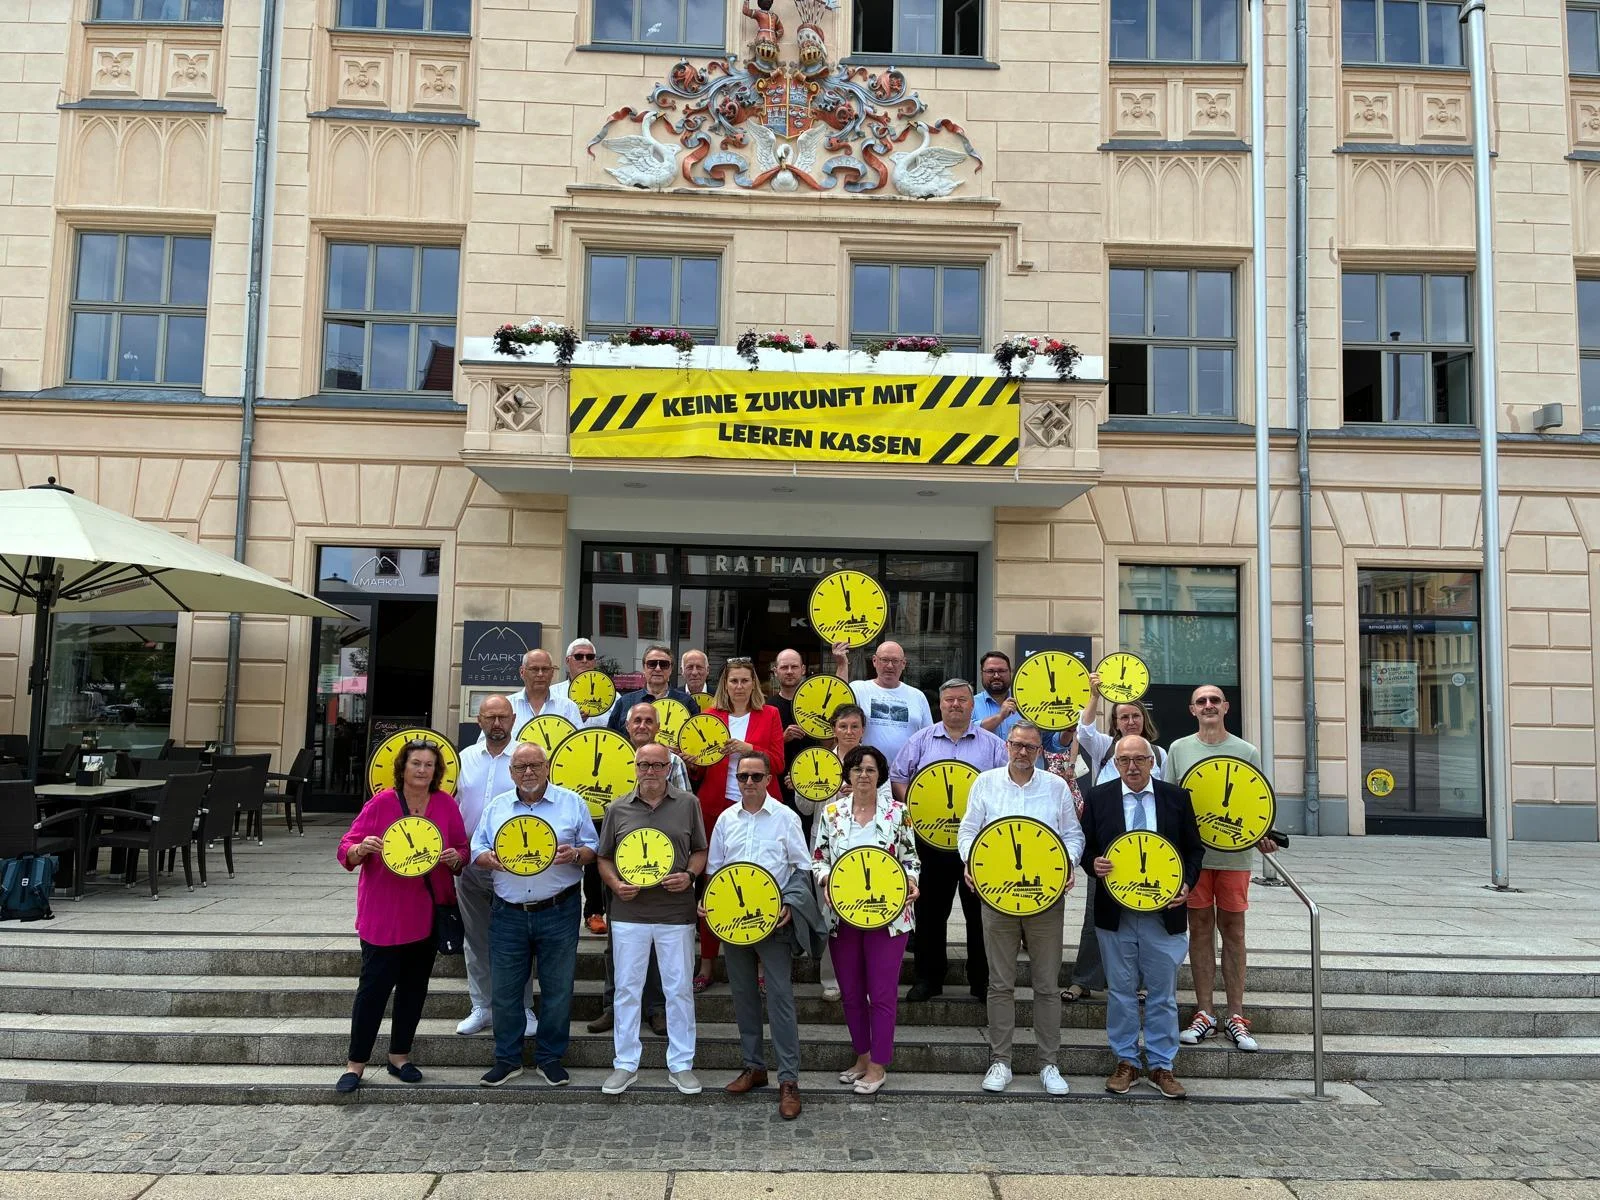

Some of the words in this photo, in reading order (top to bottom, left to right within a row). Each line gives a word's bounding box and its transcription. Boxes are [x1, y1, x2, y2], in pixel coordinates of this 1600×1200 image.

[663, 394, 738, 417] KEINE
[745, 386, 865, 412] ZUKUNFT
[872, 383, 917, 405] MIT
[718, 422, 813, 448] LEEREN
[819, 431, 921, 456] KASSEN
[716, 554, 844, 574] RATHAUS
[360, 577, 400, 587] MARKT
[478, 652, 524, 662] MARKT
